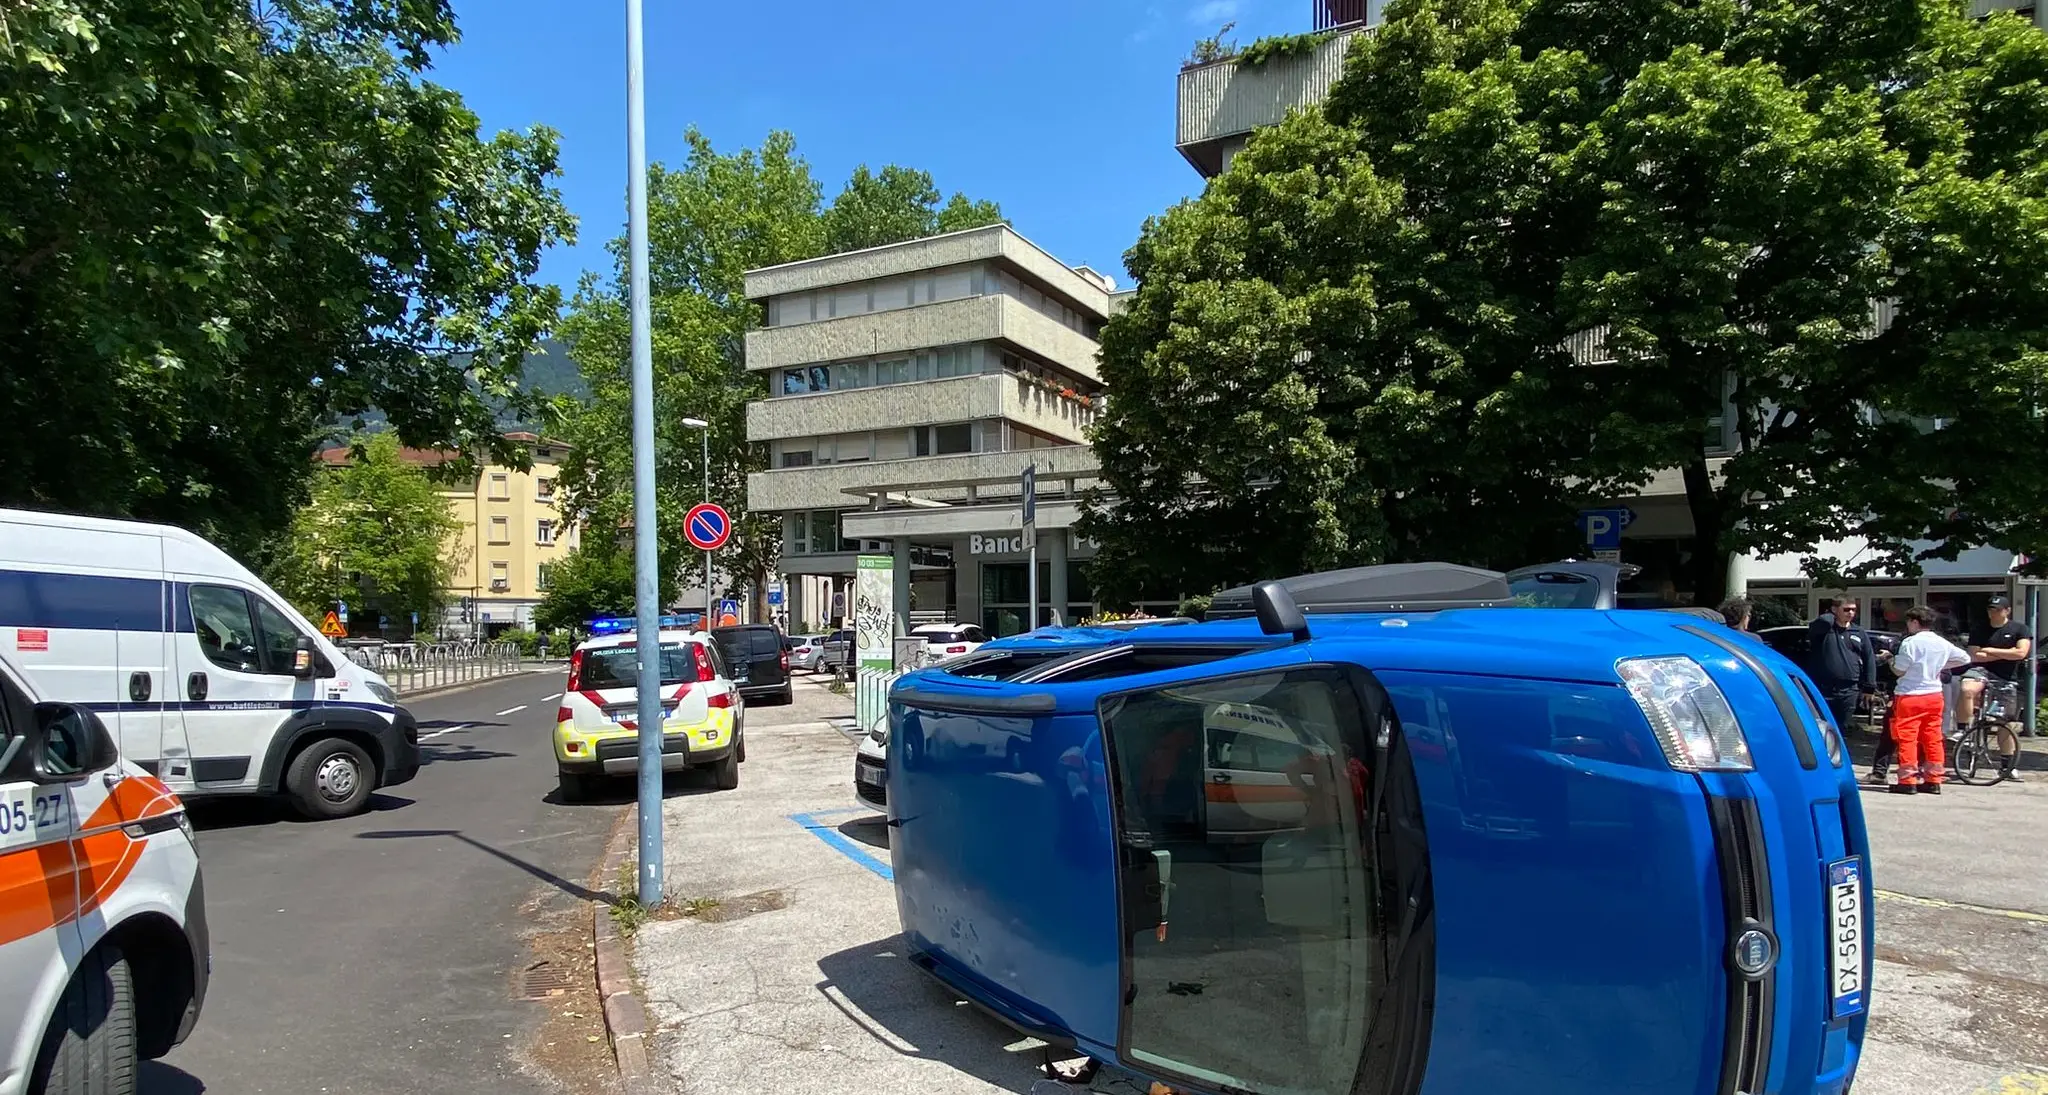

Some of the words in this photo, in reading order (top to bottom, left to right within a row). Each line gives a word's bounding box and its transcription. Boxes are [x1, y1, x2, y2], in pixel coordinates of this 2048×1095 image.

[1024, 473, 1032, 517] P
[970, 534, 1023, 554] Banc
[1587, 516, 1612, 544] P
[1749, 938, 1761, 966] FIAT
